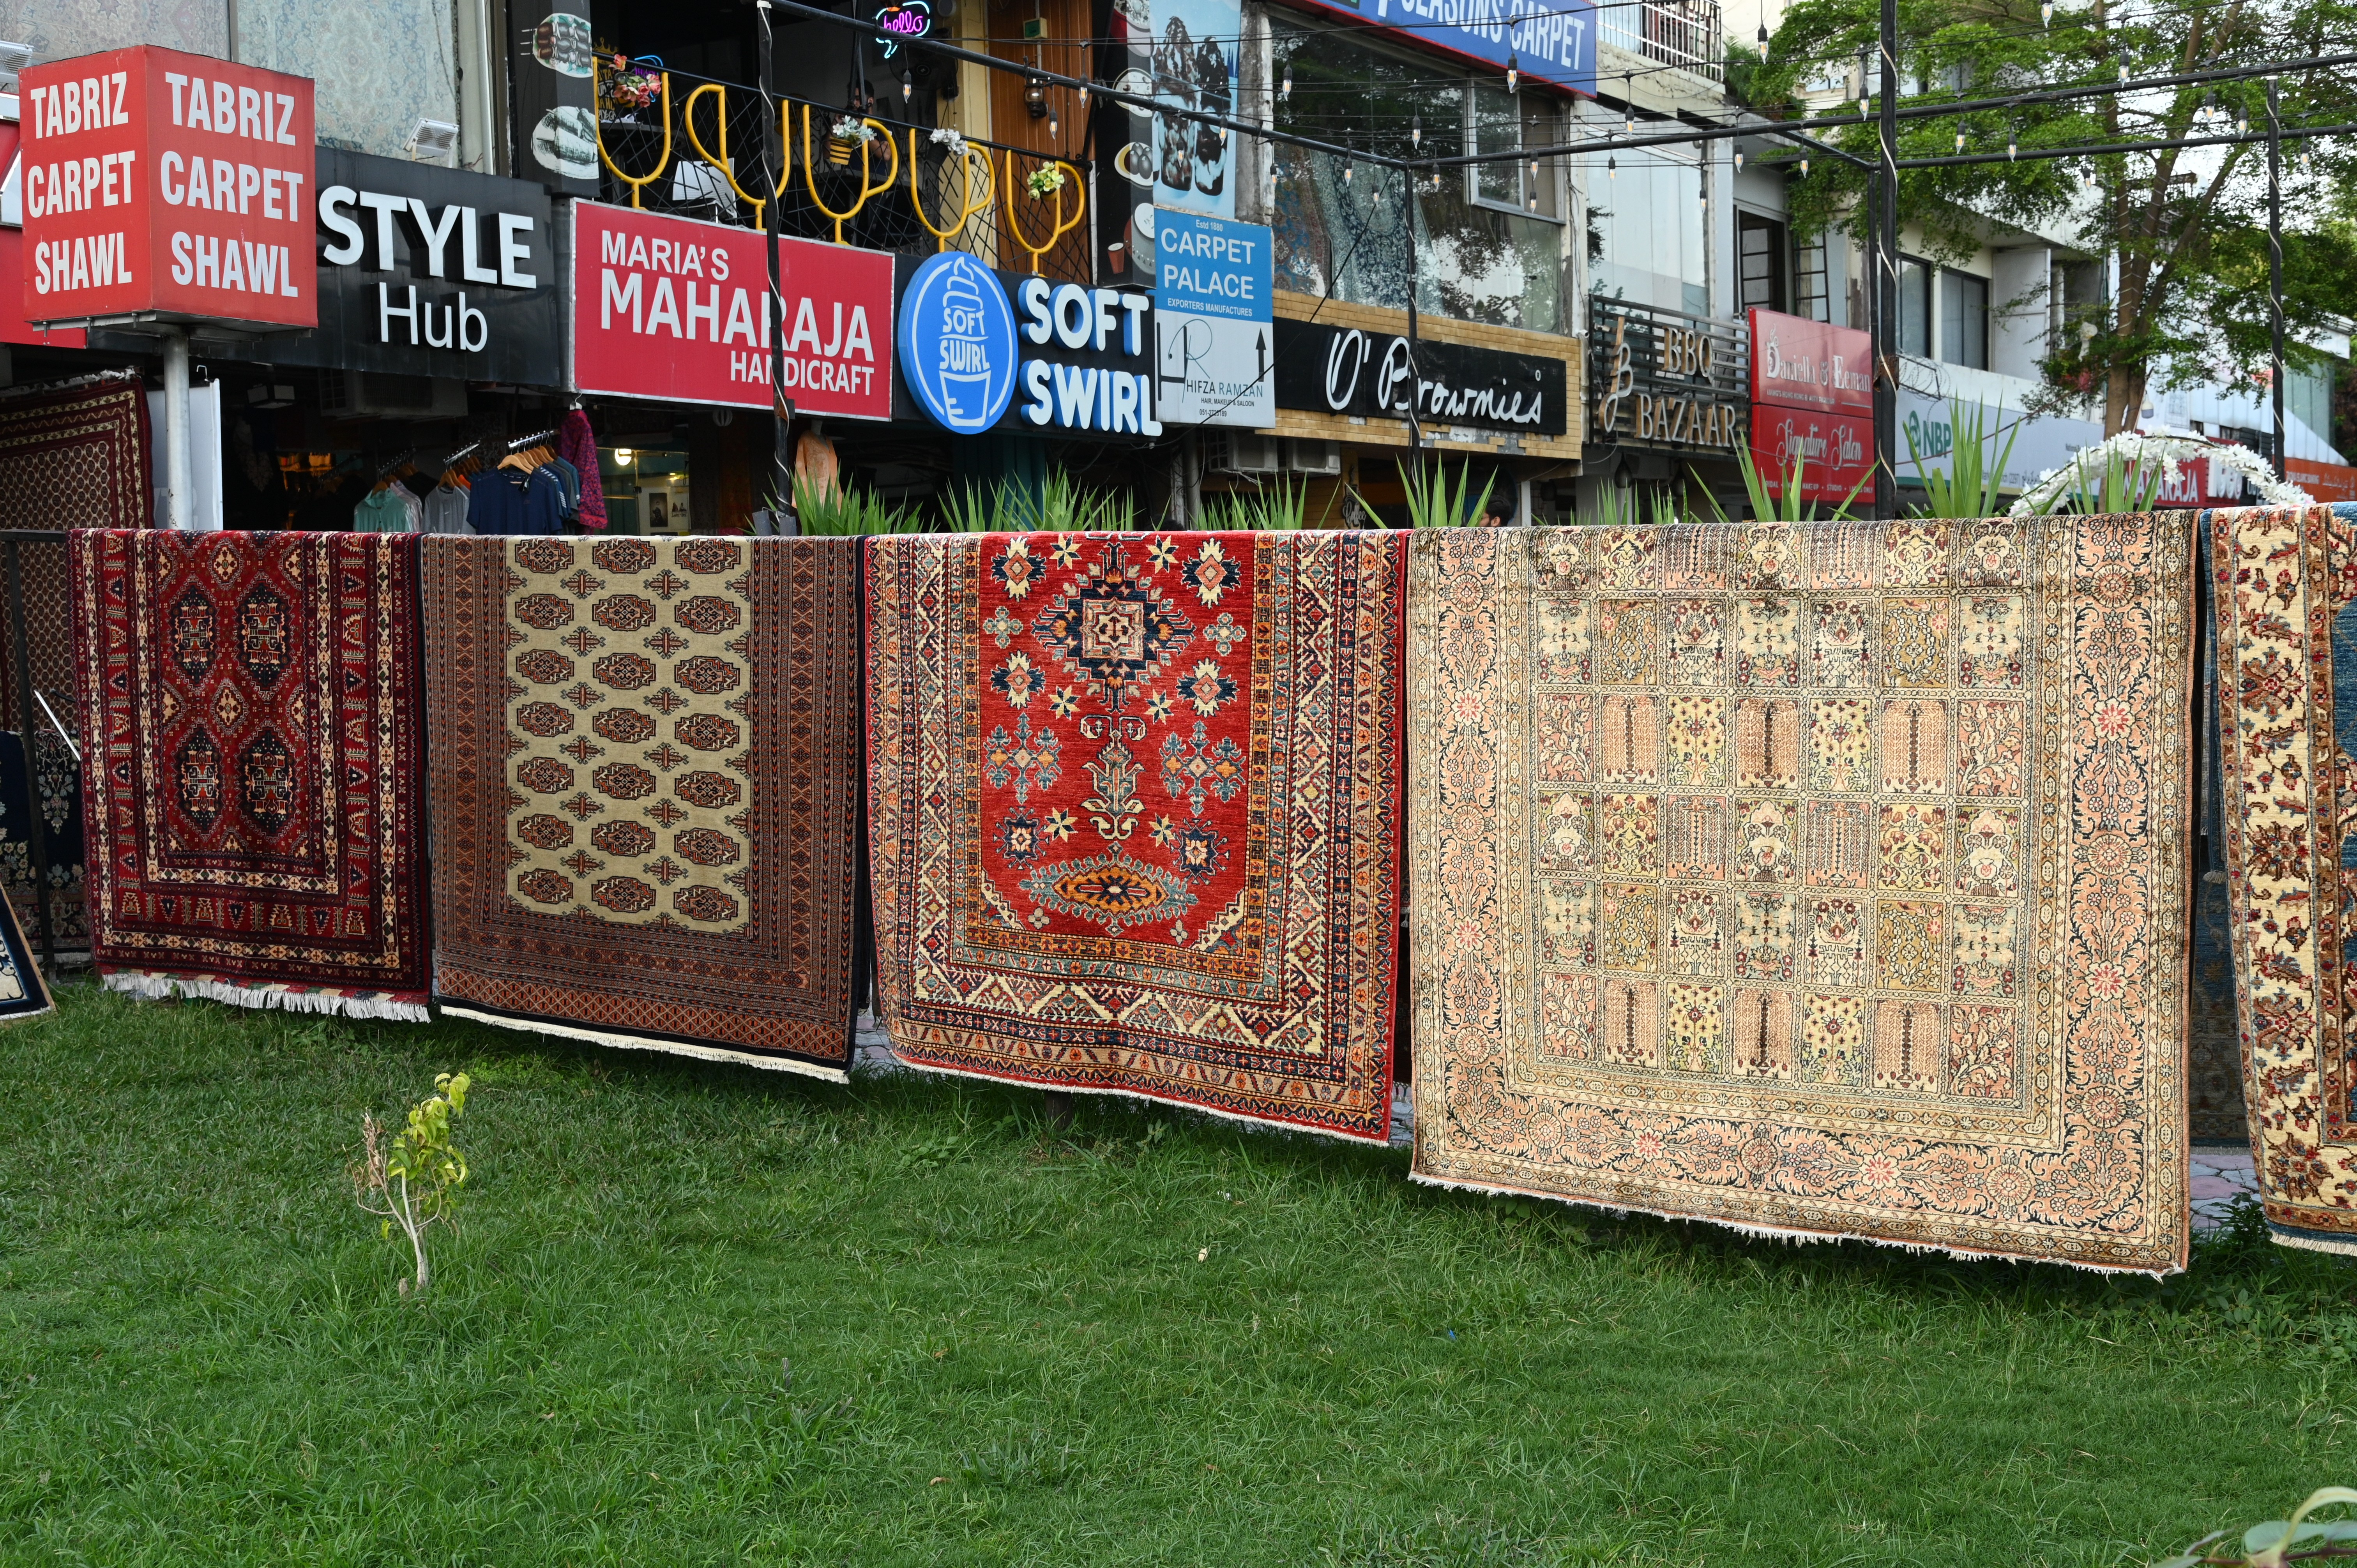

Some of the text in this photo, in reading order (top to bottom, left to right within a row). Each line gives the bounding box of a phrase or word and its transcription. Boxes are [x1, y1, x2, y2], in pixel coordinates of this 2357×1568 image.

[884, 11, 923, 33] hello
[1511, 0, 1585, 71] CARPET
[30, 71, 129, 139] TABRIZ
[165, 71, 296, 146] TABRIZ
[27, 150, 135, 218] CARPET
[161, 151, 303, 222] CARPET
[319, 185, 537, 289] STYLE
[602, 230, 729, 281] MARIA'S
[1161, 228, 1255, 265] CARPET
[1196, 219, 1223, 231] Estd 1880
[35, 232, 132, 295] SHAWL
[171, 231, 298, 297] SHAWL
[1164, 264, 1254, 300] PALACE
[379, 282, 488, 352] Hub
[601, 268, 875, 362] MAHARAJA
[942, 307, 985, 335] SOFT
[1019, 277, 1149, 356] SOFT
[1168, 298, 1253, 316] EXPORTERS MANUFACTURES
[939, 340, 990, 373] SWIRL
[1378, 337, 1541, 424] Brownies
[1663, 326, 1715, 387] BBQ
[1833, 355, 1871, 392] Eeman
[1021, 359, 1163, 437] SWIRL
[1186, 380, 1263, 397] HIFZA RAMZAN
[1635, 393, 1738, 448] BAZAAR
[1923, 420, 1952, 458] NBP
[1343, 501, 1367, 525] Coffee
